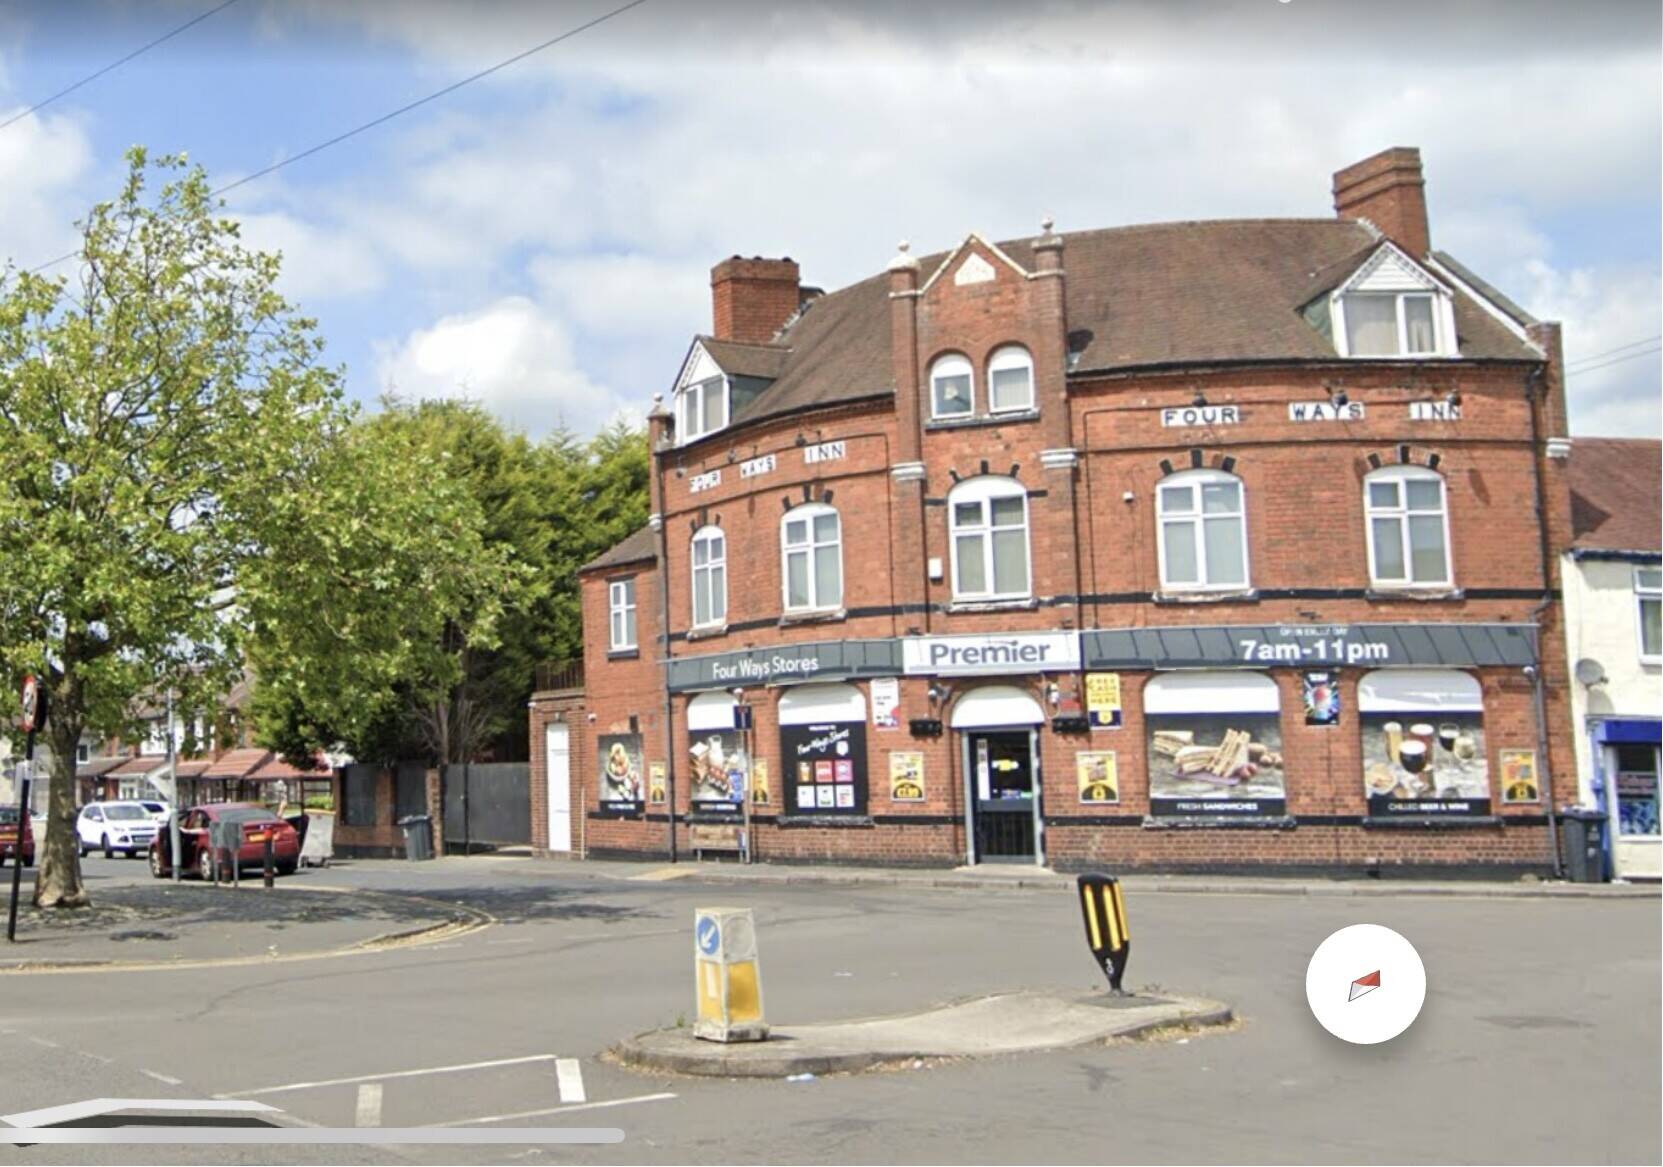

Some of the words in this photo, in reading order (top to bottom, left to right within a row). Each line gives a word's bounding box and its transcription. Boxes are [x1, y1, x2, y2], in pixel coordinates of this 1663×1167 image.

[1164, 407, 1236, 425] FOUR
[1292, 403, 1363, 419] WAYS
[1417, 402, 1460, 418] INN
[742, 456, 774, 475] WAYS
[808, 444, 845, 460] INN
[929, 640, 1051, 666] Premier
[1239, 639, 1390, 664] 7am-11pm
[712, 662, 738, 680] Four
[738, 658, 770, 680] Ways
[772, 655, 819, 673] Stores
